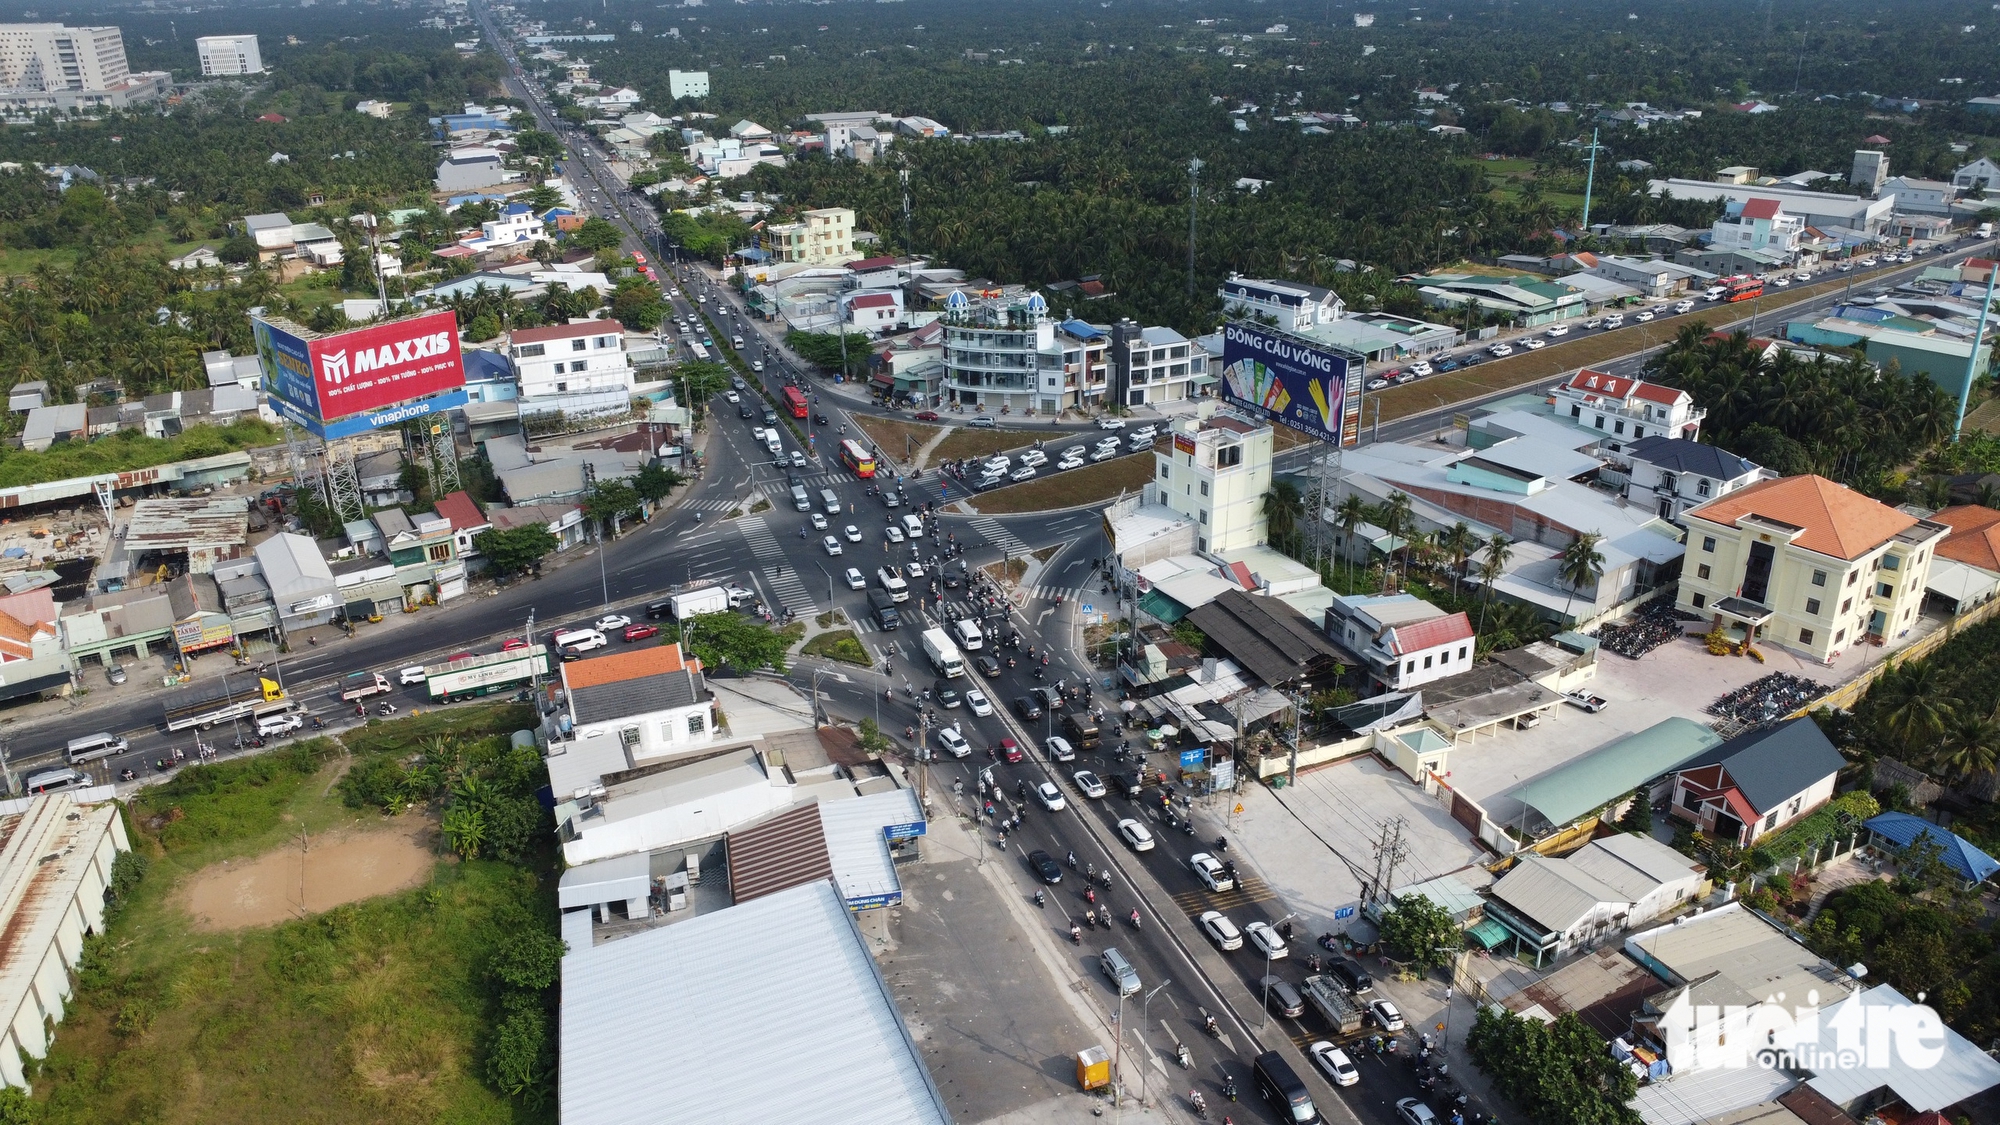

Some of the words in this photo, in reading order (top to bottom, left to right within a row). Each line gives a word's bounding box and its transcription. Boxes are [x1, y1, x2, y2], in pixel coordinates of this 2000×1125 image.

[354, 332, 450, 374] MAXXIS
[328, 388, 342, 397] 100%
[343, 383, 356, 393] CHẤT
[378, 376, 391, 384] 100%
[421, 366, 434, 374] 100%
[370, 403, 430, 426] vinaphone
[1290, 420, 1303, 430] 0251
[1304, 425, 1318, 436] 3560
[1319, 431, 1336, 444] 421-2
